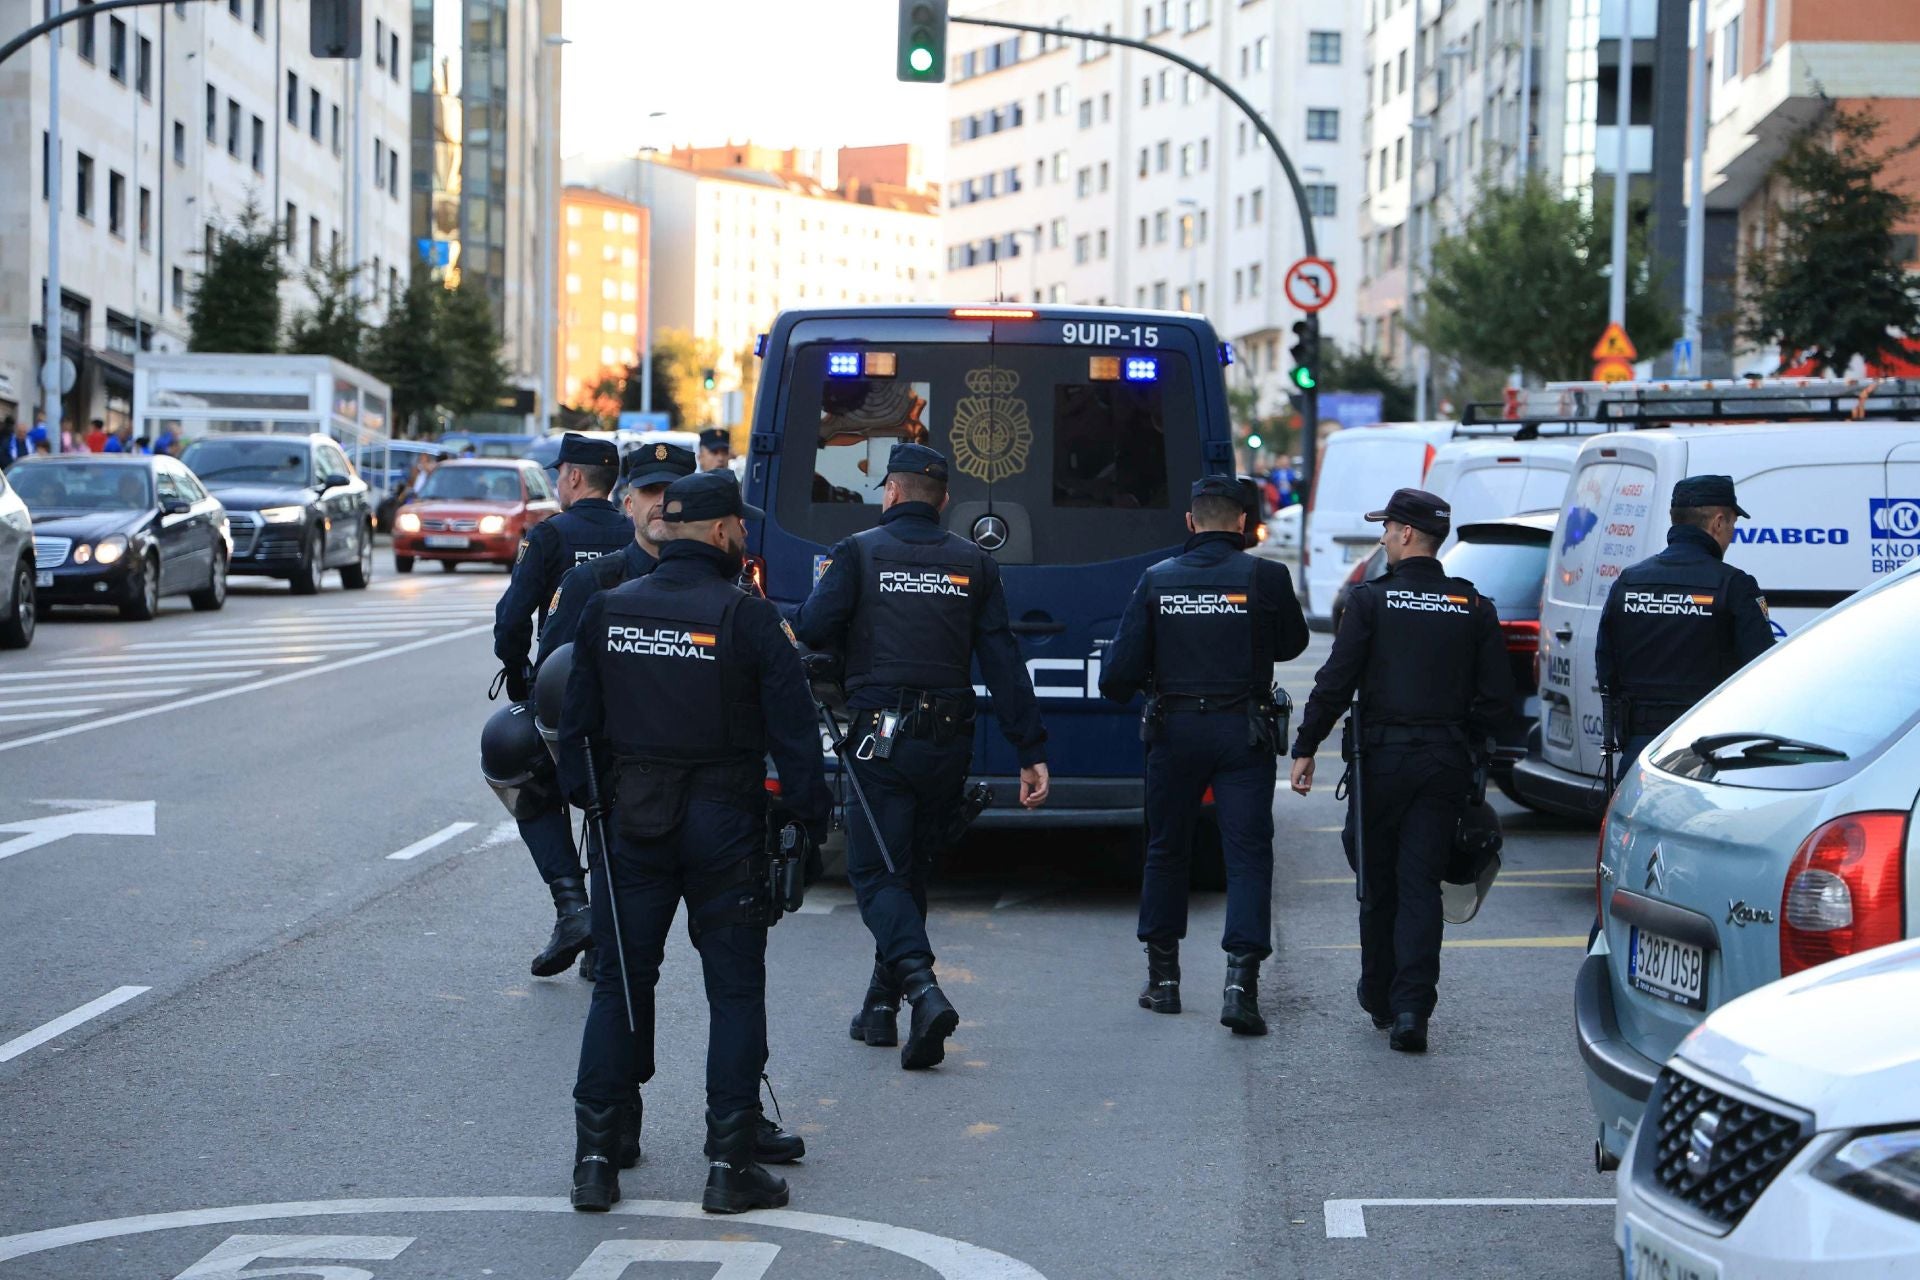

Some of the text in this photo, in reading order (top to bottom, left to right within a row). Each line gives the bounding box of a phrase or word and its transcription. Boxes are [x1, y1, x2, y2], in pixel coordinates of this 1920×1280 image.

[1062, 323, 1159, 347] 9UIP-15
[1871, 543, 1920, 557] KNO
[1872, 559, 1913, 573] BRE
[880, 571, 952, 584] POLICIA
[880, 582, 969, 597] NACIONAL
[1386, 590, 1451, 602] POLICIA
[1160, 594, 1230, 605] POLICIA
[1625, 591, 1695, 605] POLICIA
[1160, 604, 1248, 615] NACIONAL
[1387, 600, 1470, 614] NACIONAL
[1624, 602, 1713, 616] NACIONAL
[608, 626, 694, 645] POLICIA
[607, 640, 716, 661] NACIONAL
[1638, 932, 1670, 981] 5287
[1671, 944, 1700, 992] DSB
